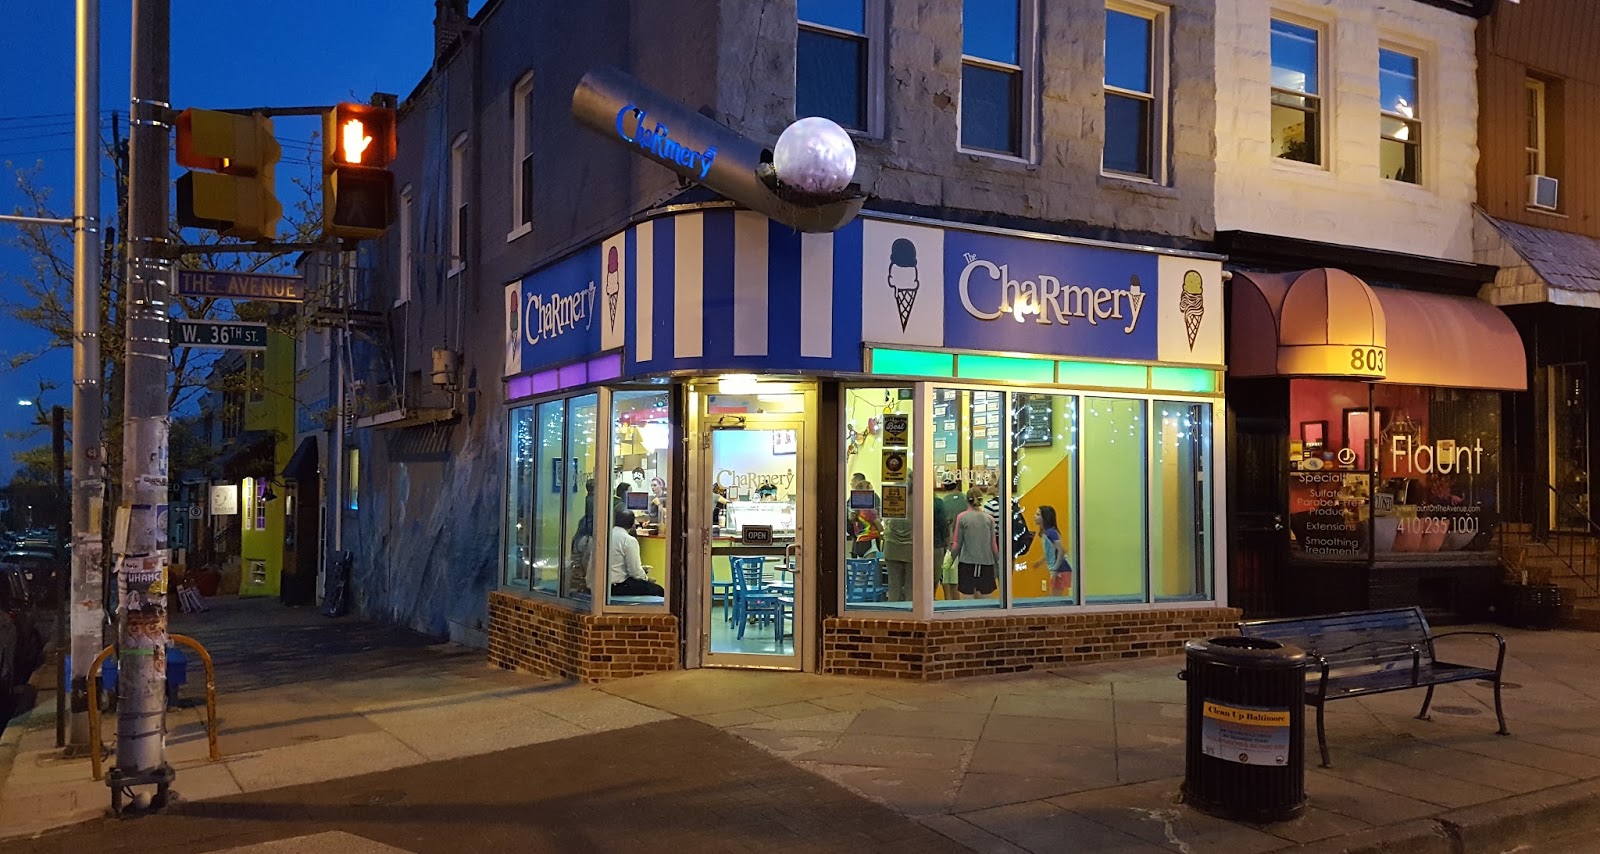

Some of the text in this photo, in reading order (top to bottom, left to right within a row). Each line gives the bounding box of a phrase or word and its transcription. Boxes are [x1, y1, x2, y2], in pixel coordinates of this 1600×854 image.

[963, 252, 978, 264] The
[182, 273, 296, 298] THE AVENUE
[182, 325, 259, 344] W. 36TH ST.
[1350, 348, 1384, 372] 803
[1392, 434, 1484, 475] Flaunt
[1306, 521, 1357, 532] Extensions
[1397, 516, 1479, 534] 410.235.1001
[748, 531, 767, 540] OPEN
[1305, 536, 1359, 549] Smoothing
[1305, 545, 1360, 556] Treatments
[1208, 706, 1286, 722] Clean Up Baltimore
